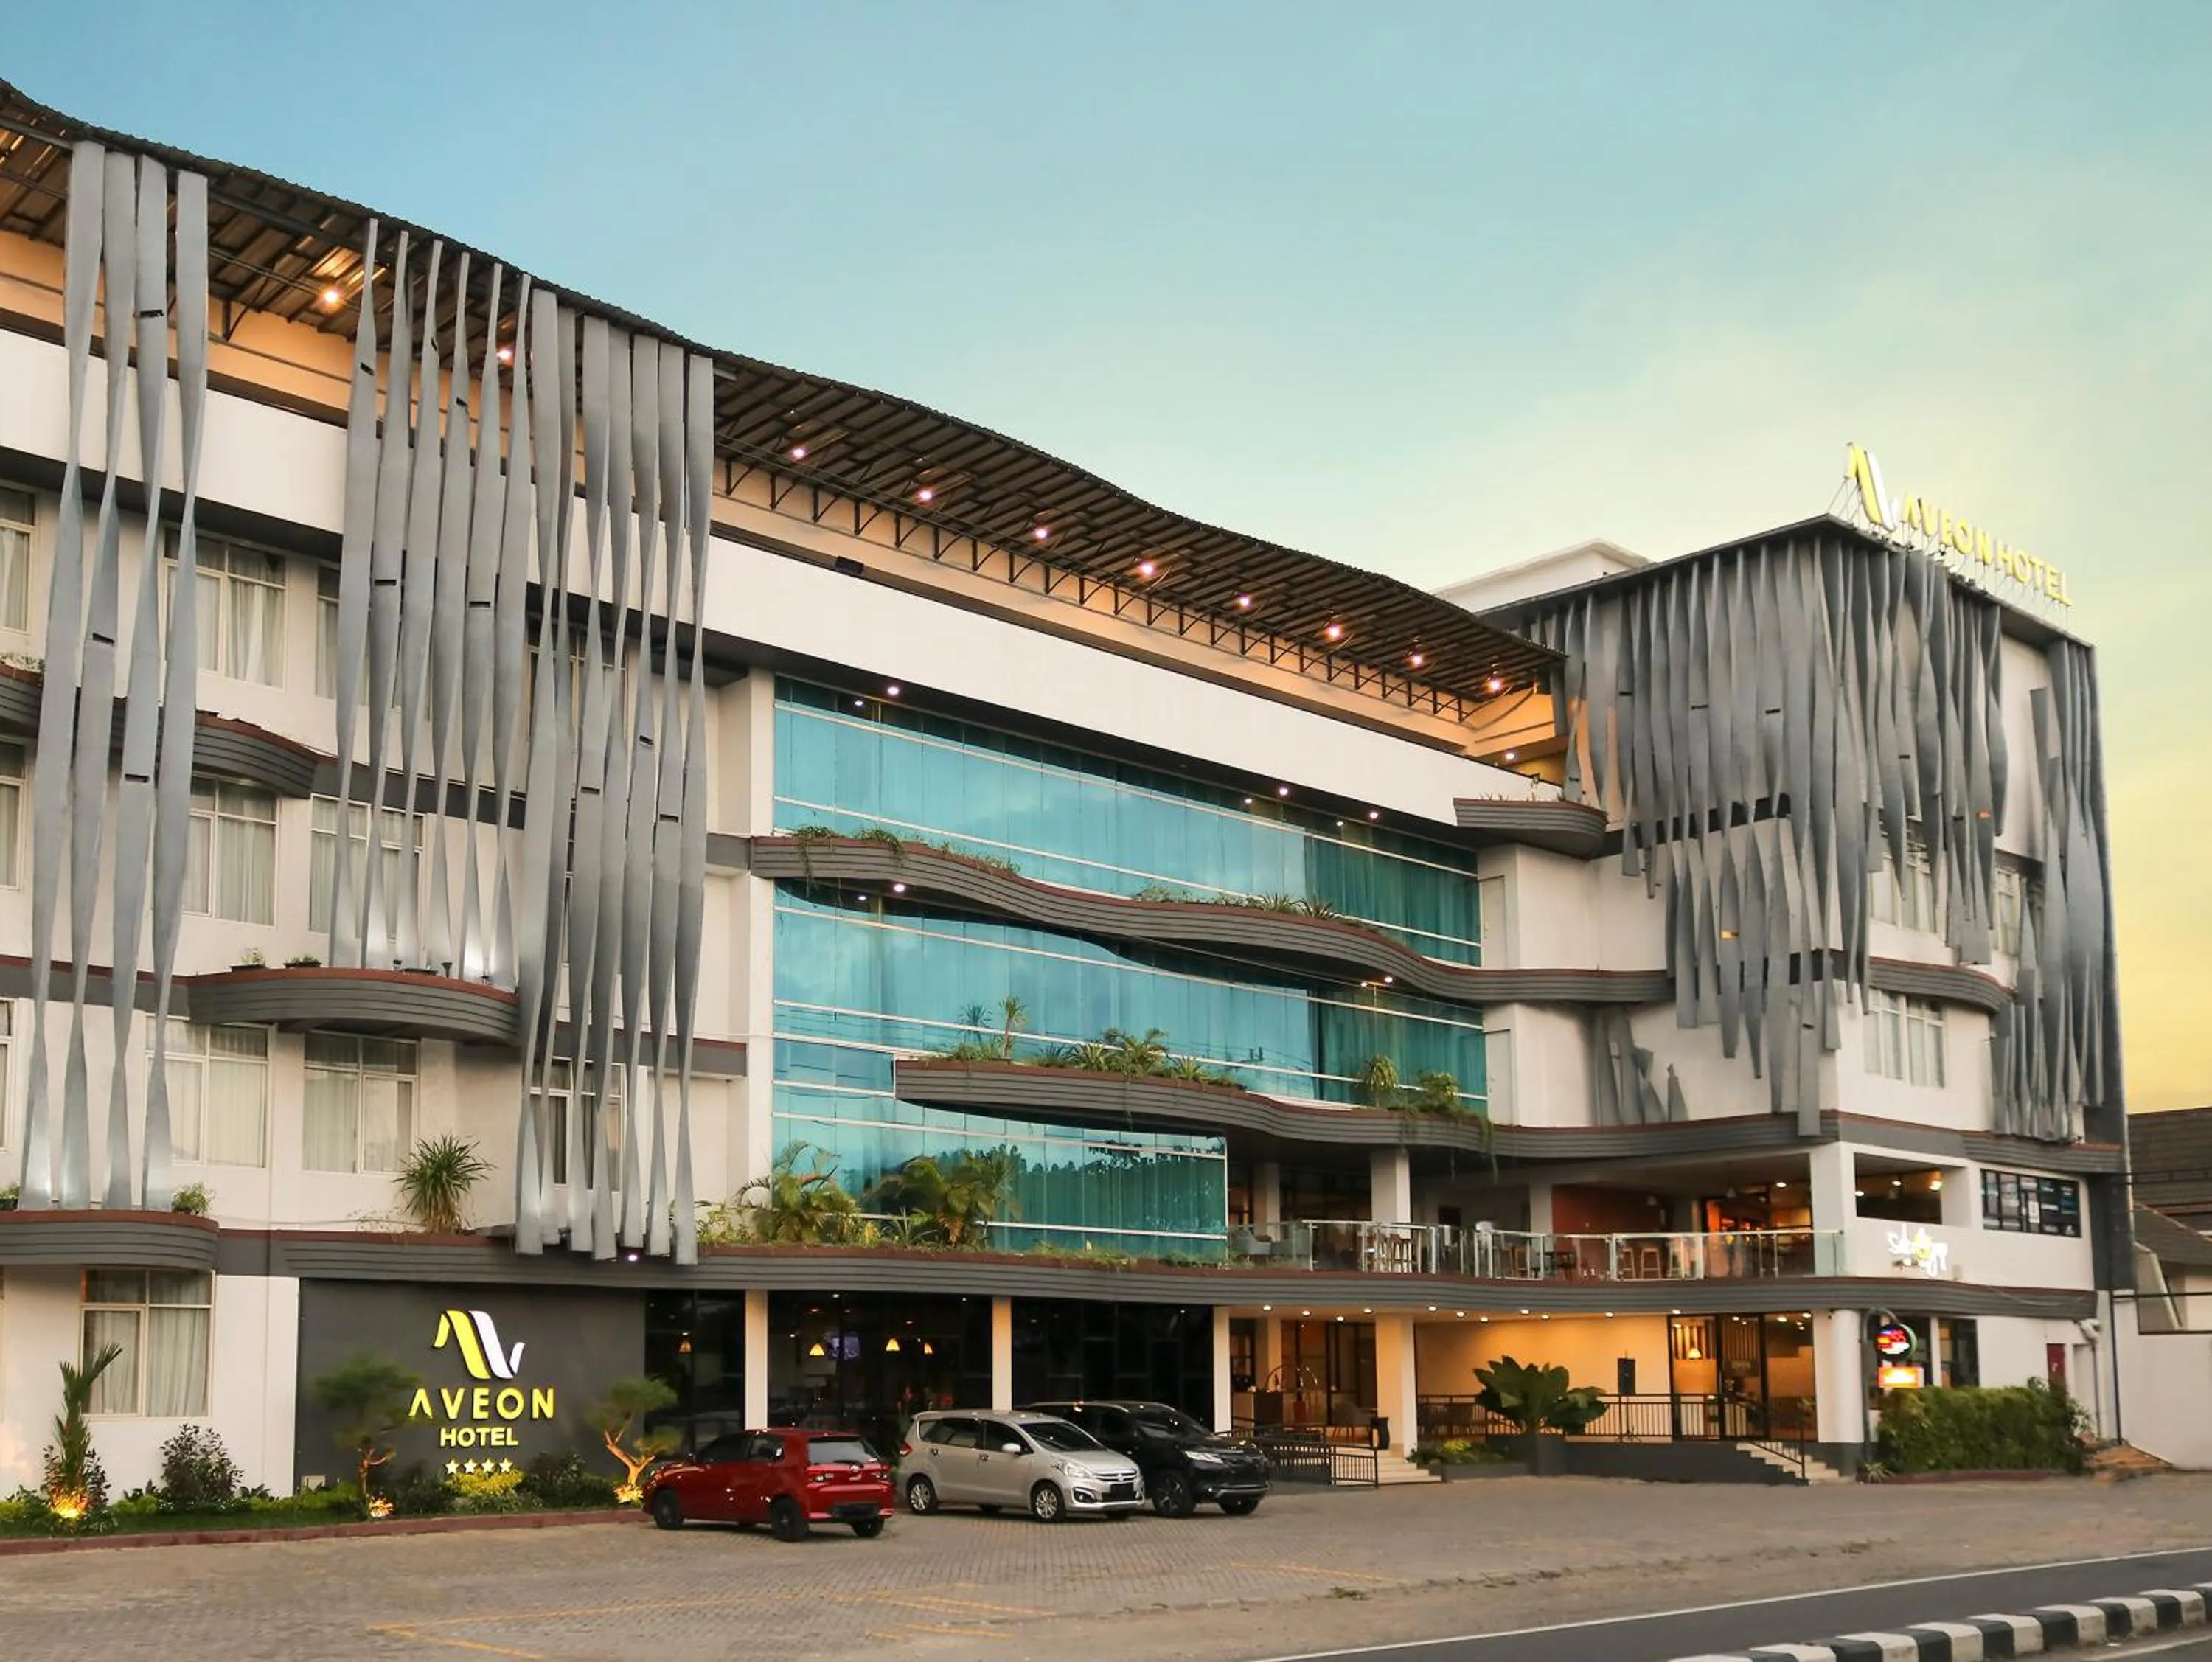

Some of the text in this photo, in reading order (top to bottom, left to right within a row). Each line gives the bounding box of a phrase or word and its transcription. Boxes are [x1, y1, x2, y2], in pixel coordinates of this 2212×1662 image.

[1902, 491, 2074, 606] AVEON HOTEL
[408, 1388, 554, 1420] AVEON
[440, 1427, 518, 1447] HOTEL
